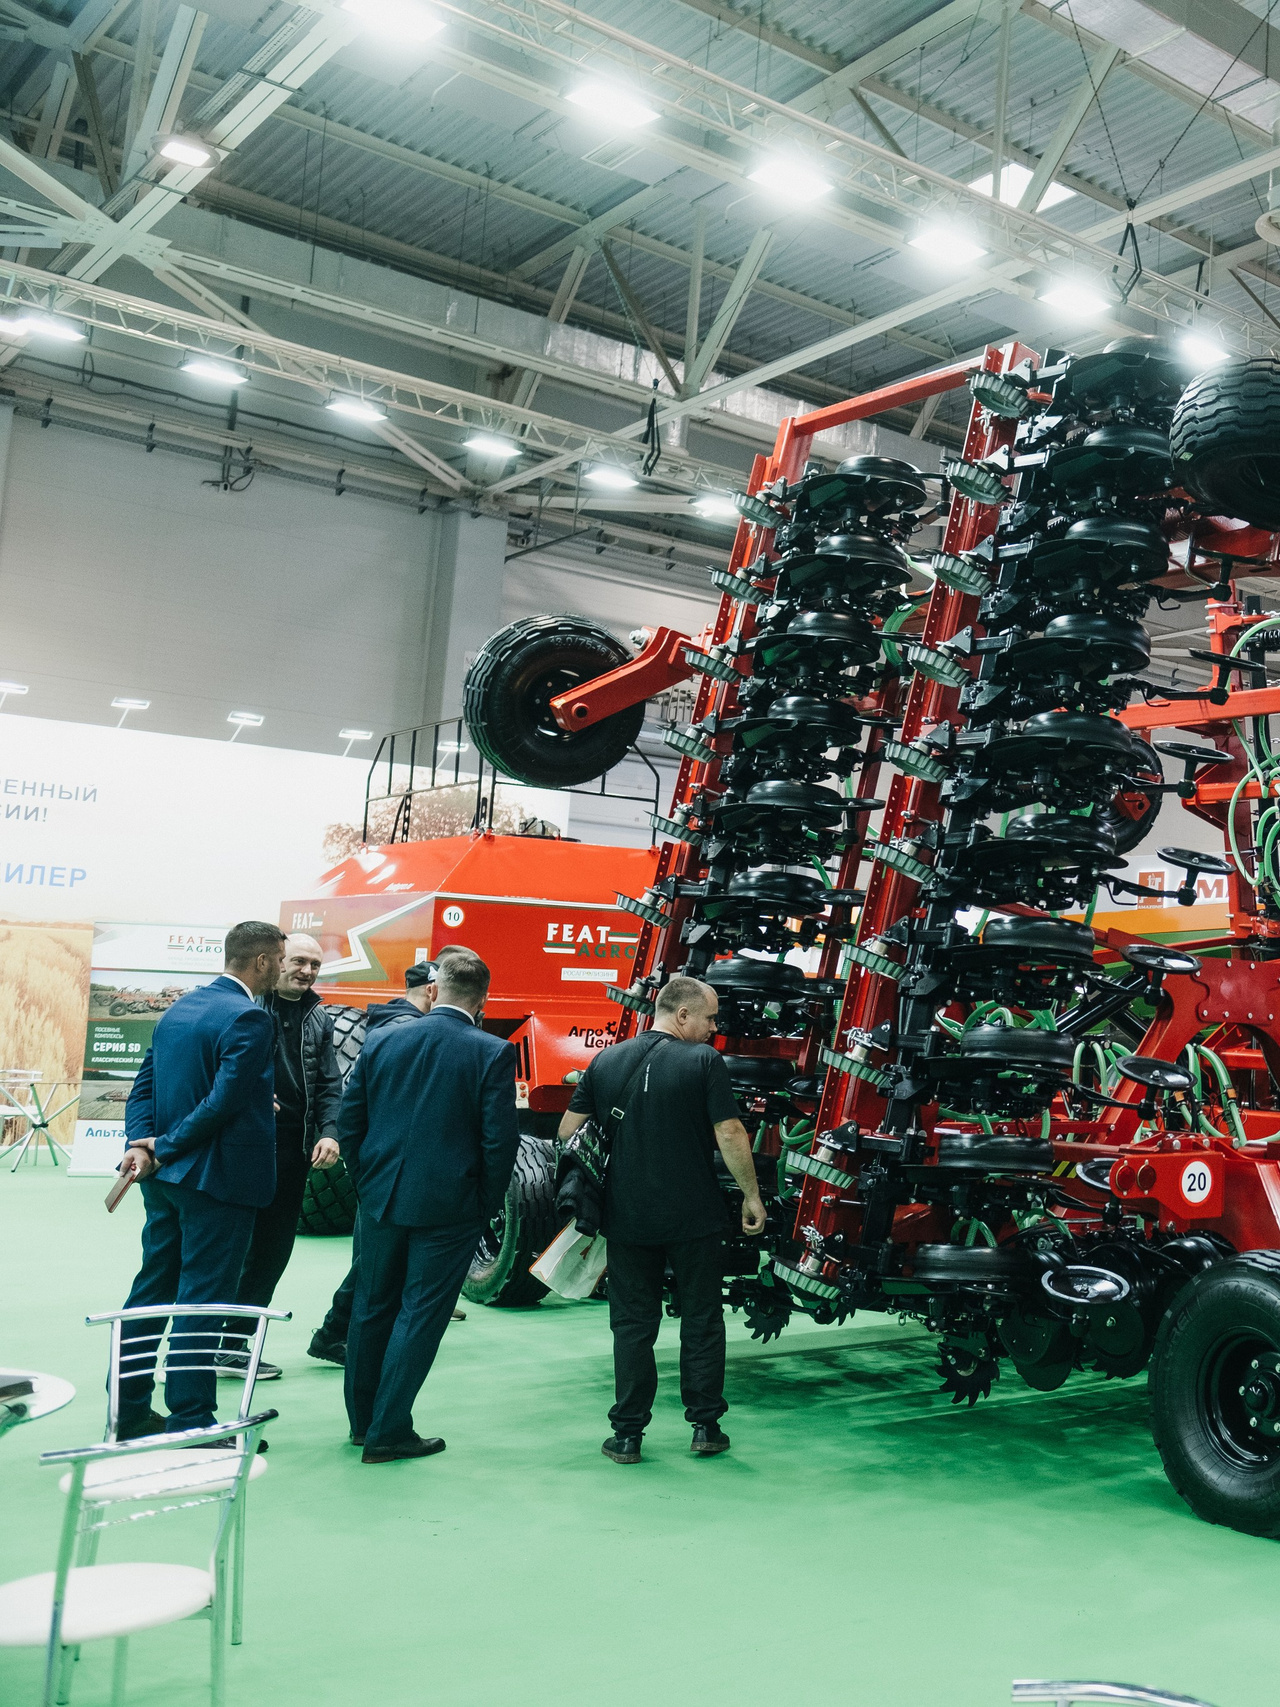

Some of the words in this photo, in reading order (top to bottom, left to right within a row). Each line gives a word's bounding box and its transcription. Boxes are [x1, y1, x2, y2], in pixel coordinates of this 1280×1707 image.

[0, 779, 97, 802] ЕННЫЙ
[0, 803, 48, 822] ИИ!
[0, 862, 87, 888] ИЛЕР
[447, 911, 461, 923] 10
[169, 935, 205, 944] FEAT
[547, 922, 611, 943] FEAT
[186, 945, 223, 954] AGRO
[578, 943, 638, 959] AGRO
[93, 1042, 126, 1053] СЕРИЯ
[127, 1042, 141, 1053] SD
[1187, 1172, 1207, 1192] 20
